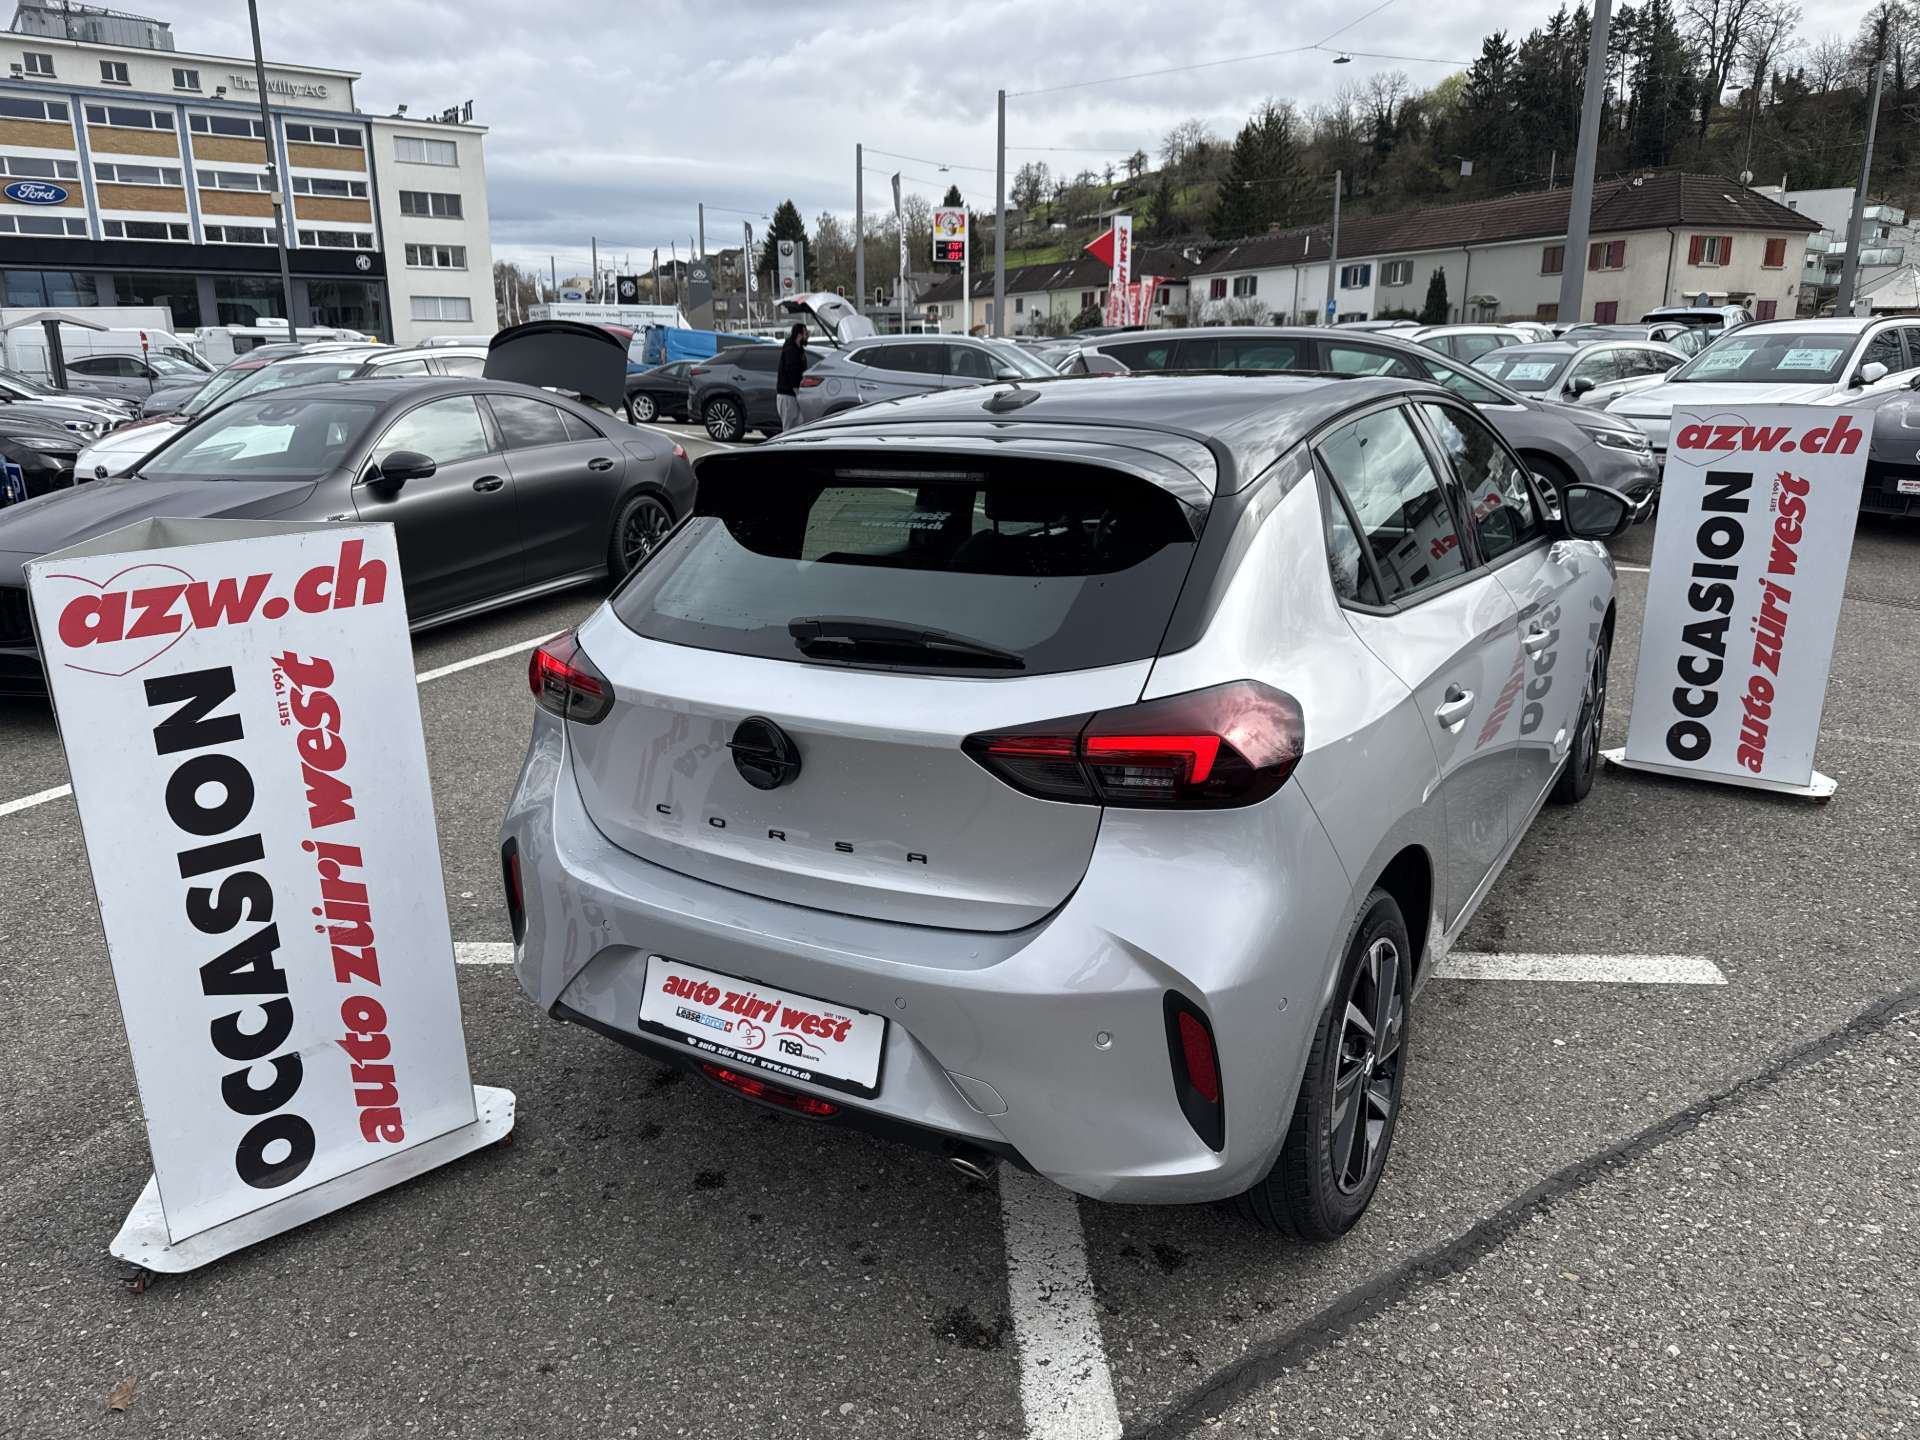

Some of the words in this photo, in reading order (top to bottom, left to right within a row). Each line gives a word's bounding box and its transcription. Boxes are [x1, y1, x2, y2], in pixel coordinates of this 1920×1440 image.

[304, 81, 328, 98] AG
[17, 184, 56, 200] Ford
[1633, 178, 1643, 186] 48
[1676, 415, 1863, 454] azw.ch
[1767, 470, 1810, 575] west
[58, 538, 387, 648] azw.ch
[1666, 471, 1754, 762] OCCASION
[1750, 578, 1792, 677] züri
[272, 667, 286, 696] 1991
[277, 701, 291, 726] SEIT
[271, 650, 356, 829] west
[1736, 675, 1775, 773] auto
[656, 803, 927, 864] CORSA
[143, 666, 316, 1190] OCCASION
[301, 840, 382, 987] züri
[662, 975, 720, 1006] auto
[719, 992, 781, 1024] züri
[781, 1007, 852, 1043] west
[335, 995, 405, 1144] auto
[698, 1041, 716, 1053] auto
[717, 1046, 735, 1059] züri
[737, 1053, 756, 1065] west
[761, 1060, 811, 1081] www.azw.ch
[779, 1038, 802, 1056] nsa
